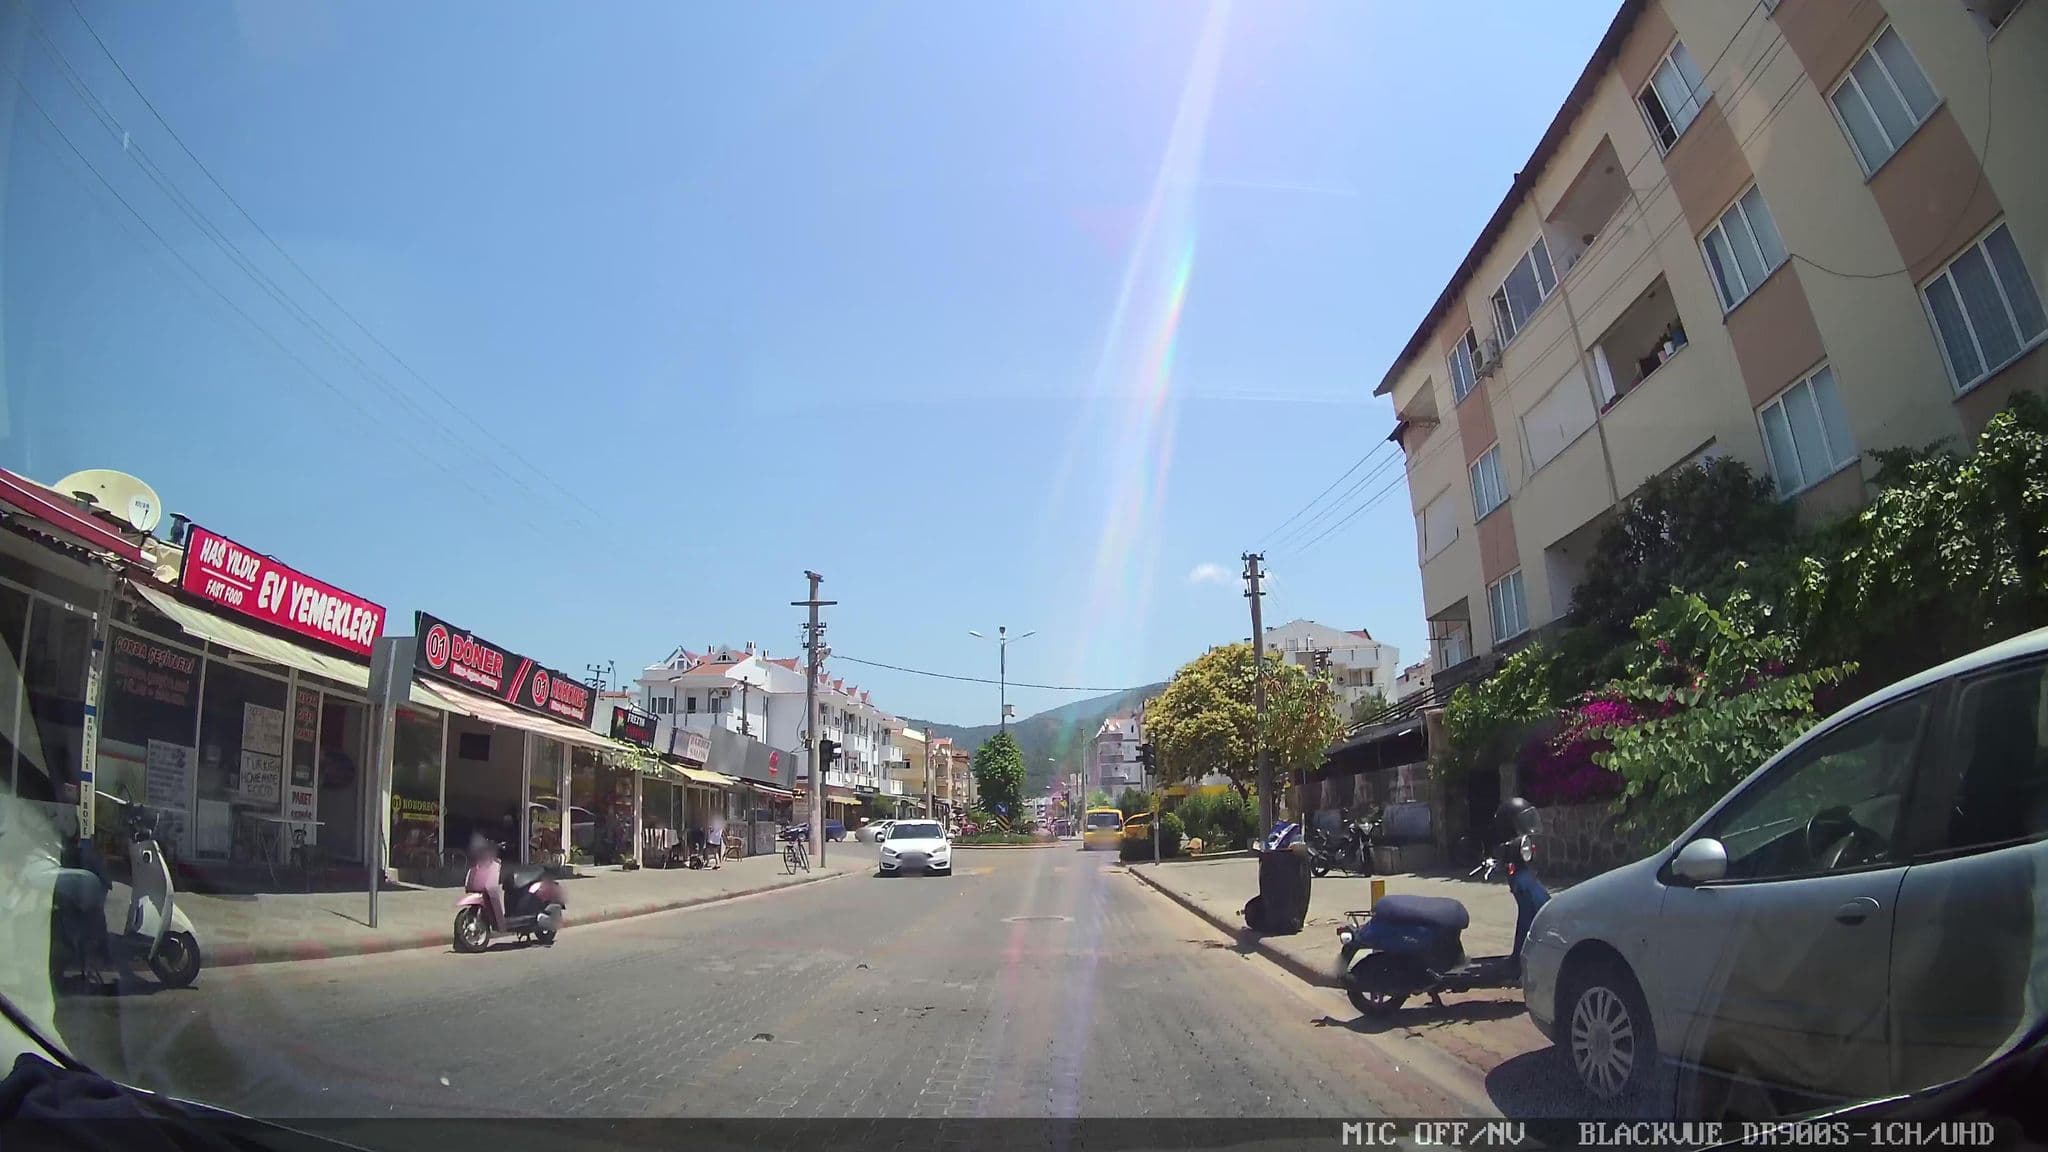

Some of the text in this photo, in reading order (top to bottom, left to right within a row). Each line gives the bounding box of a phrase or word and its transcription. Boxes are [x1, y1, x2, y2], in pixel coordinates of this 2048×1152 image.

[226, 547, 260, 583] YILDIZ
[205, 579, 243, 606] FAST FOOD
[258, 571, 378, 647] EV YEMEKLERİ
[431, 634, 447, 660] 01
[451, 633, 504, 678] DÖNER
[535, 677, 547, 698] 01
